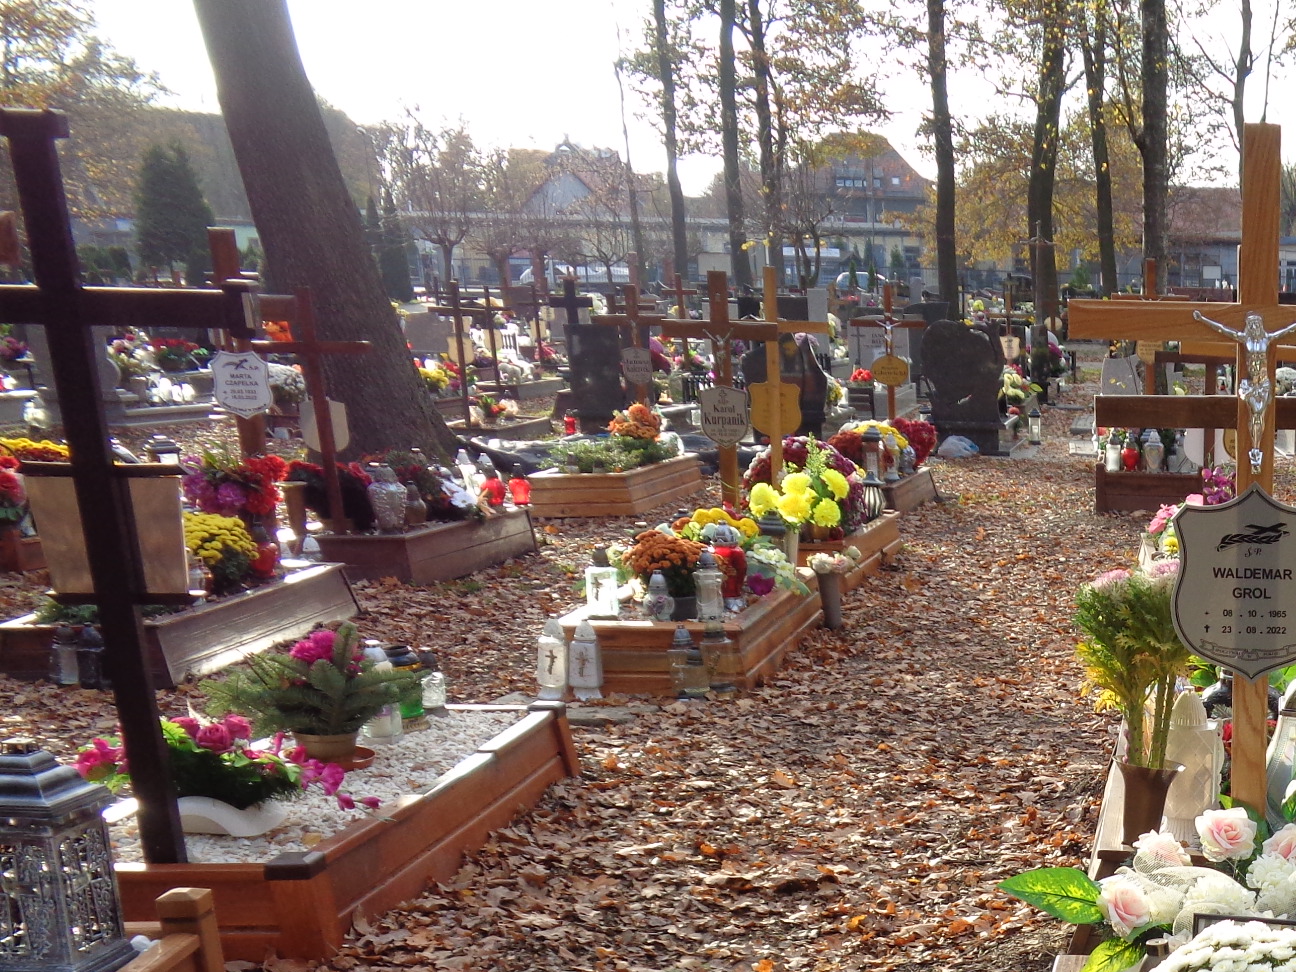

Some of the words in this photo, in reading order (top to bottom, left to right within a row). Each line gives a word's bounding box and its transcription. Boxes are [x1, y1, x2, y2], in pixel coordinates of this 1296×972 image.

[713, 404, 736, 413] Karol
[703, 411, 746, 428] Kurpanik
[1212, 567, 1293, 580] WALDEMAR
[1232, 587, 1272, 600] GROL
[1222, 609, 1233, 618] 08
[1268, 610, 1287, 618] 1965
[1221, 625, 1232, 634] 23
[1266, 626, 1287, 635] 2022
